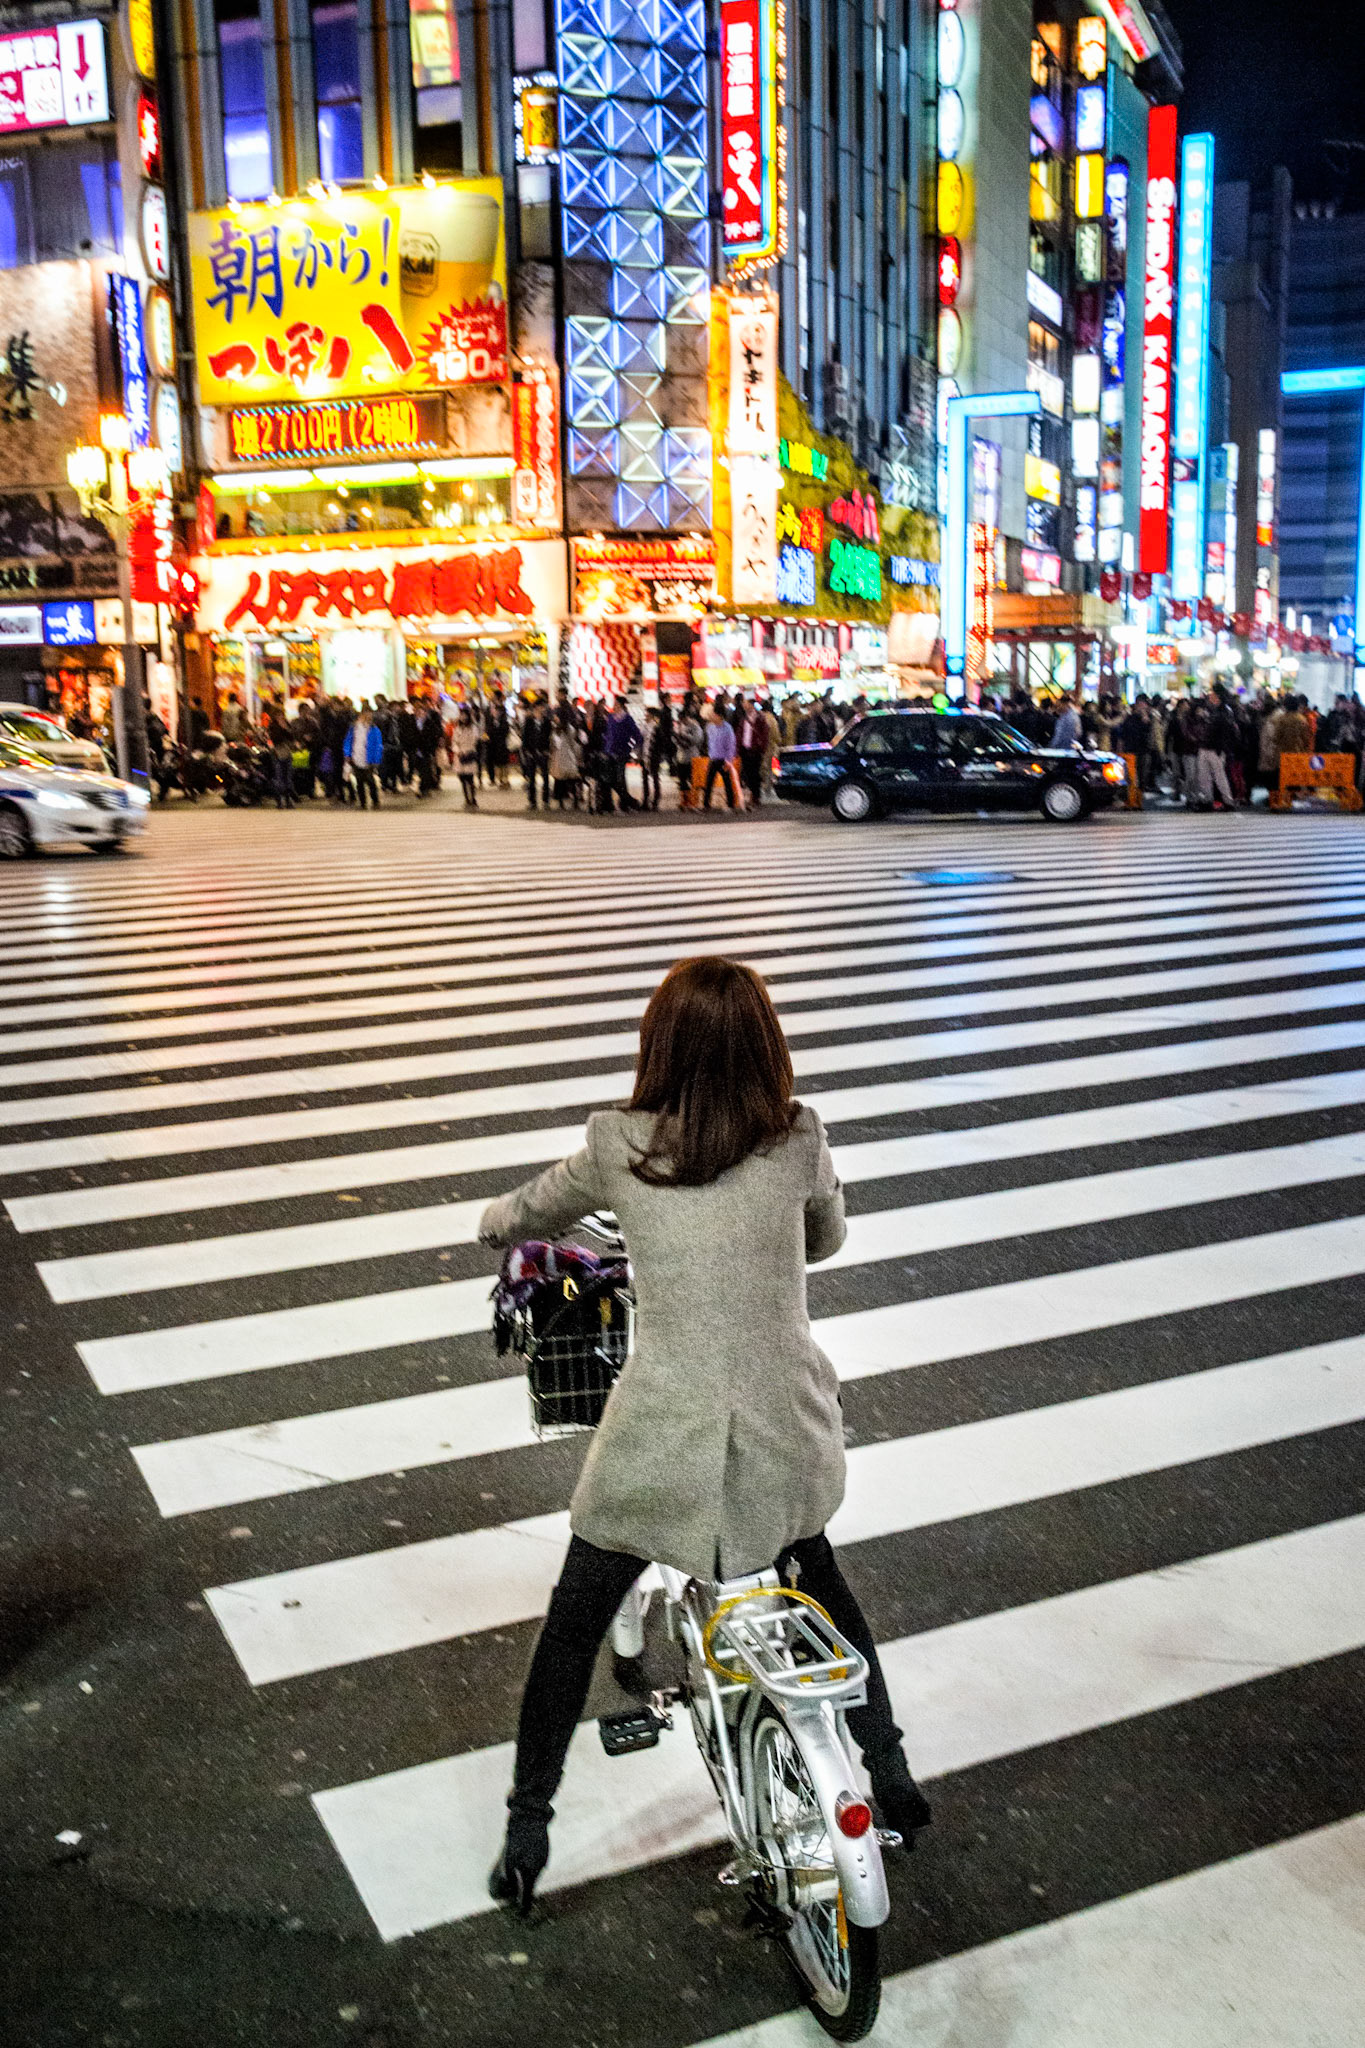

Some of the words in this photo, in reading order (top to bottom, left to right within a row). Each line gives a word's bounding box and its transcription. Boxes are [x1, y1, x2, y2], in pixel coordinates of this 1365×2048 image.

[205, 216, 392, 325] 朝から!
[1145, 177, 1176, 322] SHIDAX
[1140, 334, 1169, 511] KARAOKE
